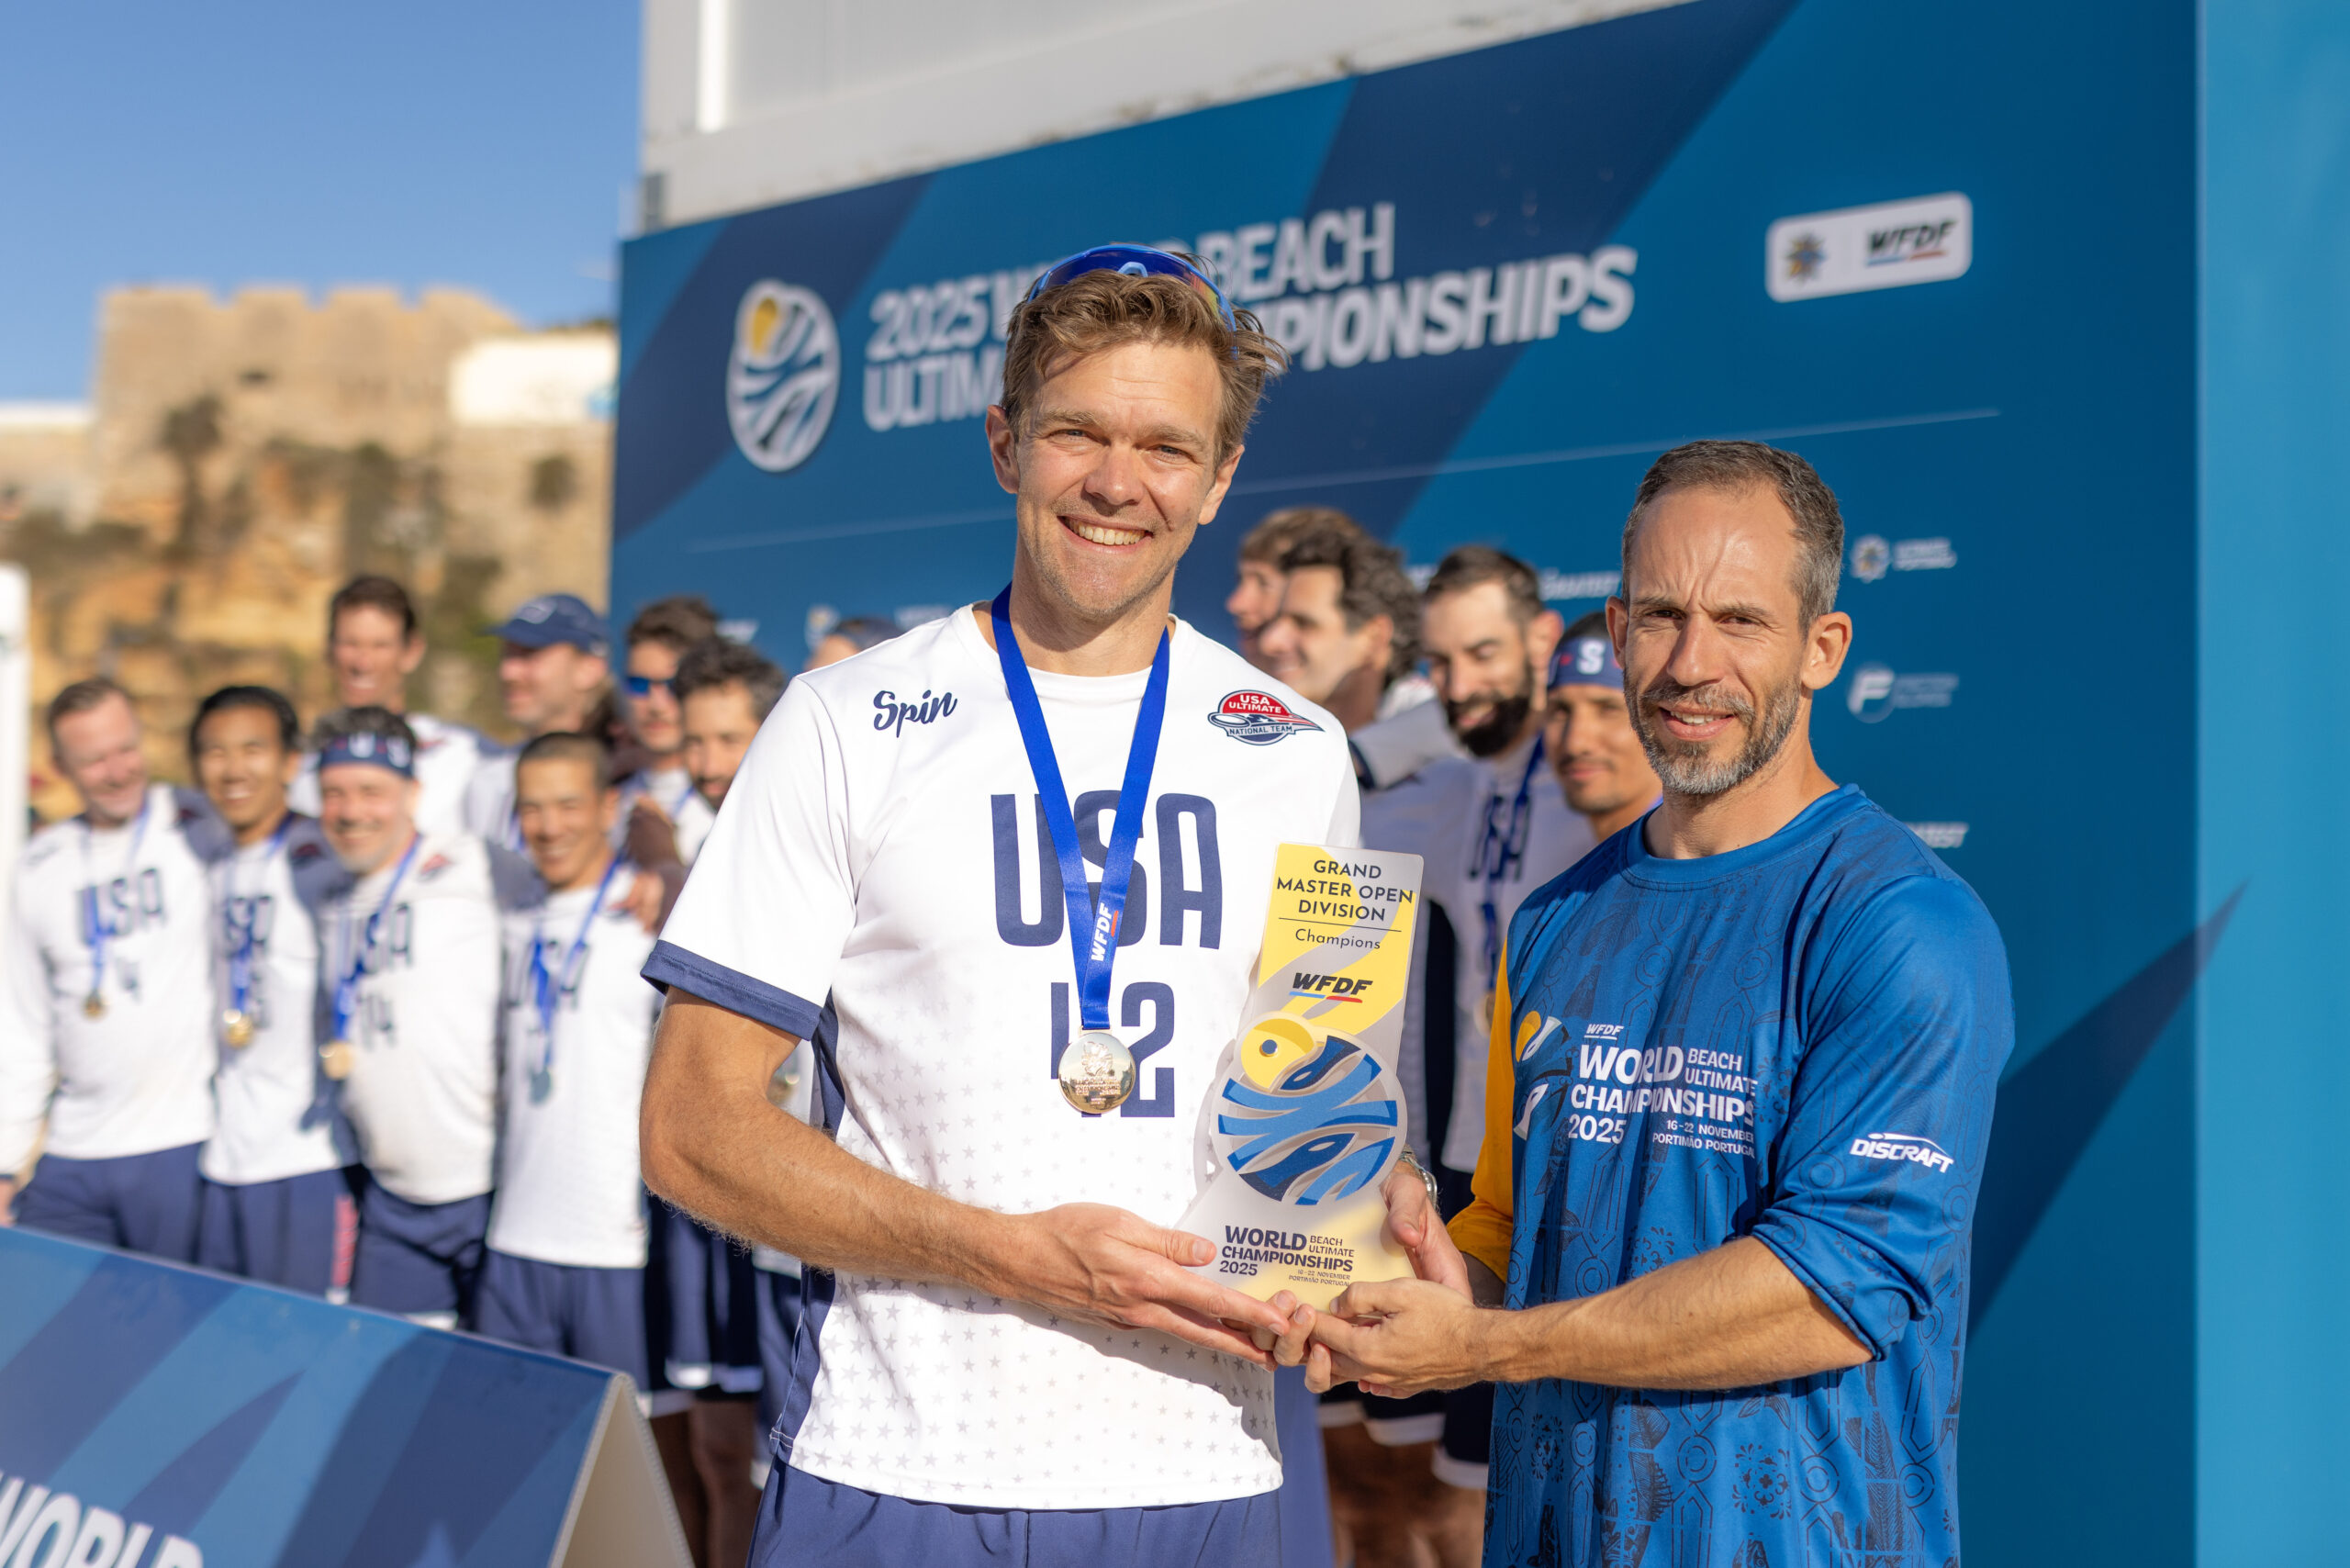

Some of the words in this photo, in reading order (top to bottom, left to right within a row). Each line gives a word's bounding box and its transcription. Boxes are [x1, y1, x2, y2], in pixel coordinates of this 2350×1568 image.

[1866, 218, 1959, 256] WFDF
[867, 286, 990, 361] 2025
[1196, 200, 1396, 303] BEACH
[862, 344, 1008, 432] ULTIM
[1228, 700, 1281, 713] ULTIMATE
[1239, 694, 1270, 706] USA
[873, 689, 958, 738] Spin
[1229, 726, 1269, 735] NATIONAL
[1270, 724, 1292, 733] TEAM
[990, 790, 1223, 950] USA
[1314, 859, 1382, 879] GRAND
[1276, 877, 1352, 897] MASTER
[1359, 885, 1414, 903] OPEN
[1298, 899, 1385, 922] DIVISION
[1091, 902, 1112, 961] WFDF
[1295, 928, 1381, 949] Champions
[1292, 972, 1373, 995] WFDF
[1585, 1024, 1624, 1036] WFDF
[1579, 1044, 1684, 1085] WORLD
[1687, 1047, 1742, 1072] BEACH
[1684, 1067, 1758, 1096] ULTIMATE
[1571, 1084, 1754, 1127] CHAMPIONSHIPS
[1568, 1114, 1628, 1144] 2025
[1705, 1139, 1755, 1159] PORTUGA
[1849, 1138, 1954, 1173] DISCRAFT
[1225, 1225, 1307, 1250] WORLD
[1309, 1235, 1343, 1247] BEACH
[1222, 1246, 1353, 1272] CHAMPIONSHIPS
[1308, 1244, 1355, 1258] ULTIMATE
[1219, 1260, 1259, 1276] 2025
[1317, 1271, 1351, 1281] NOVEMBER
